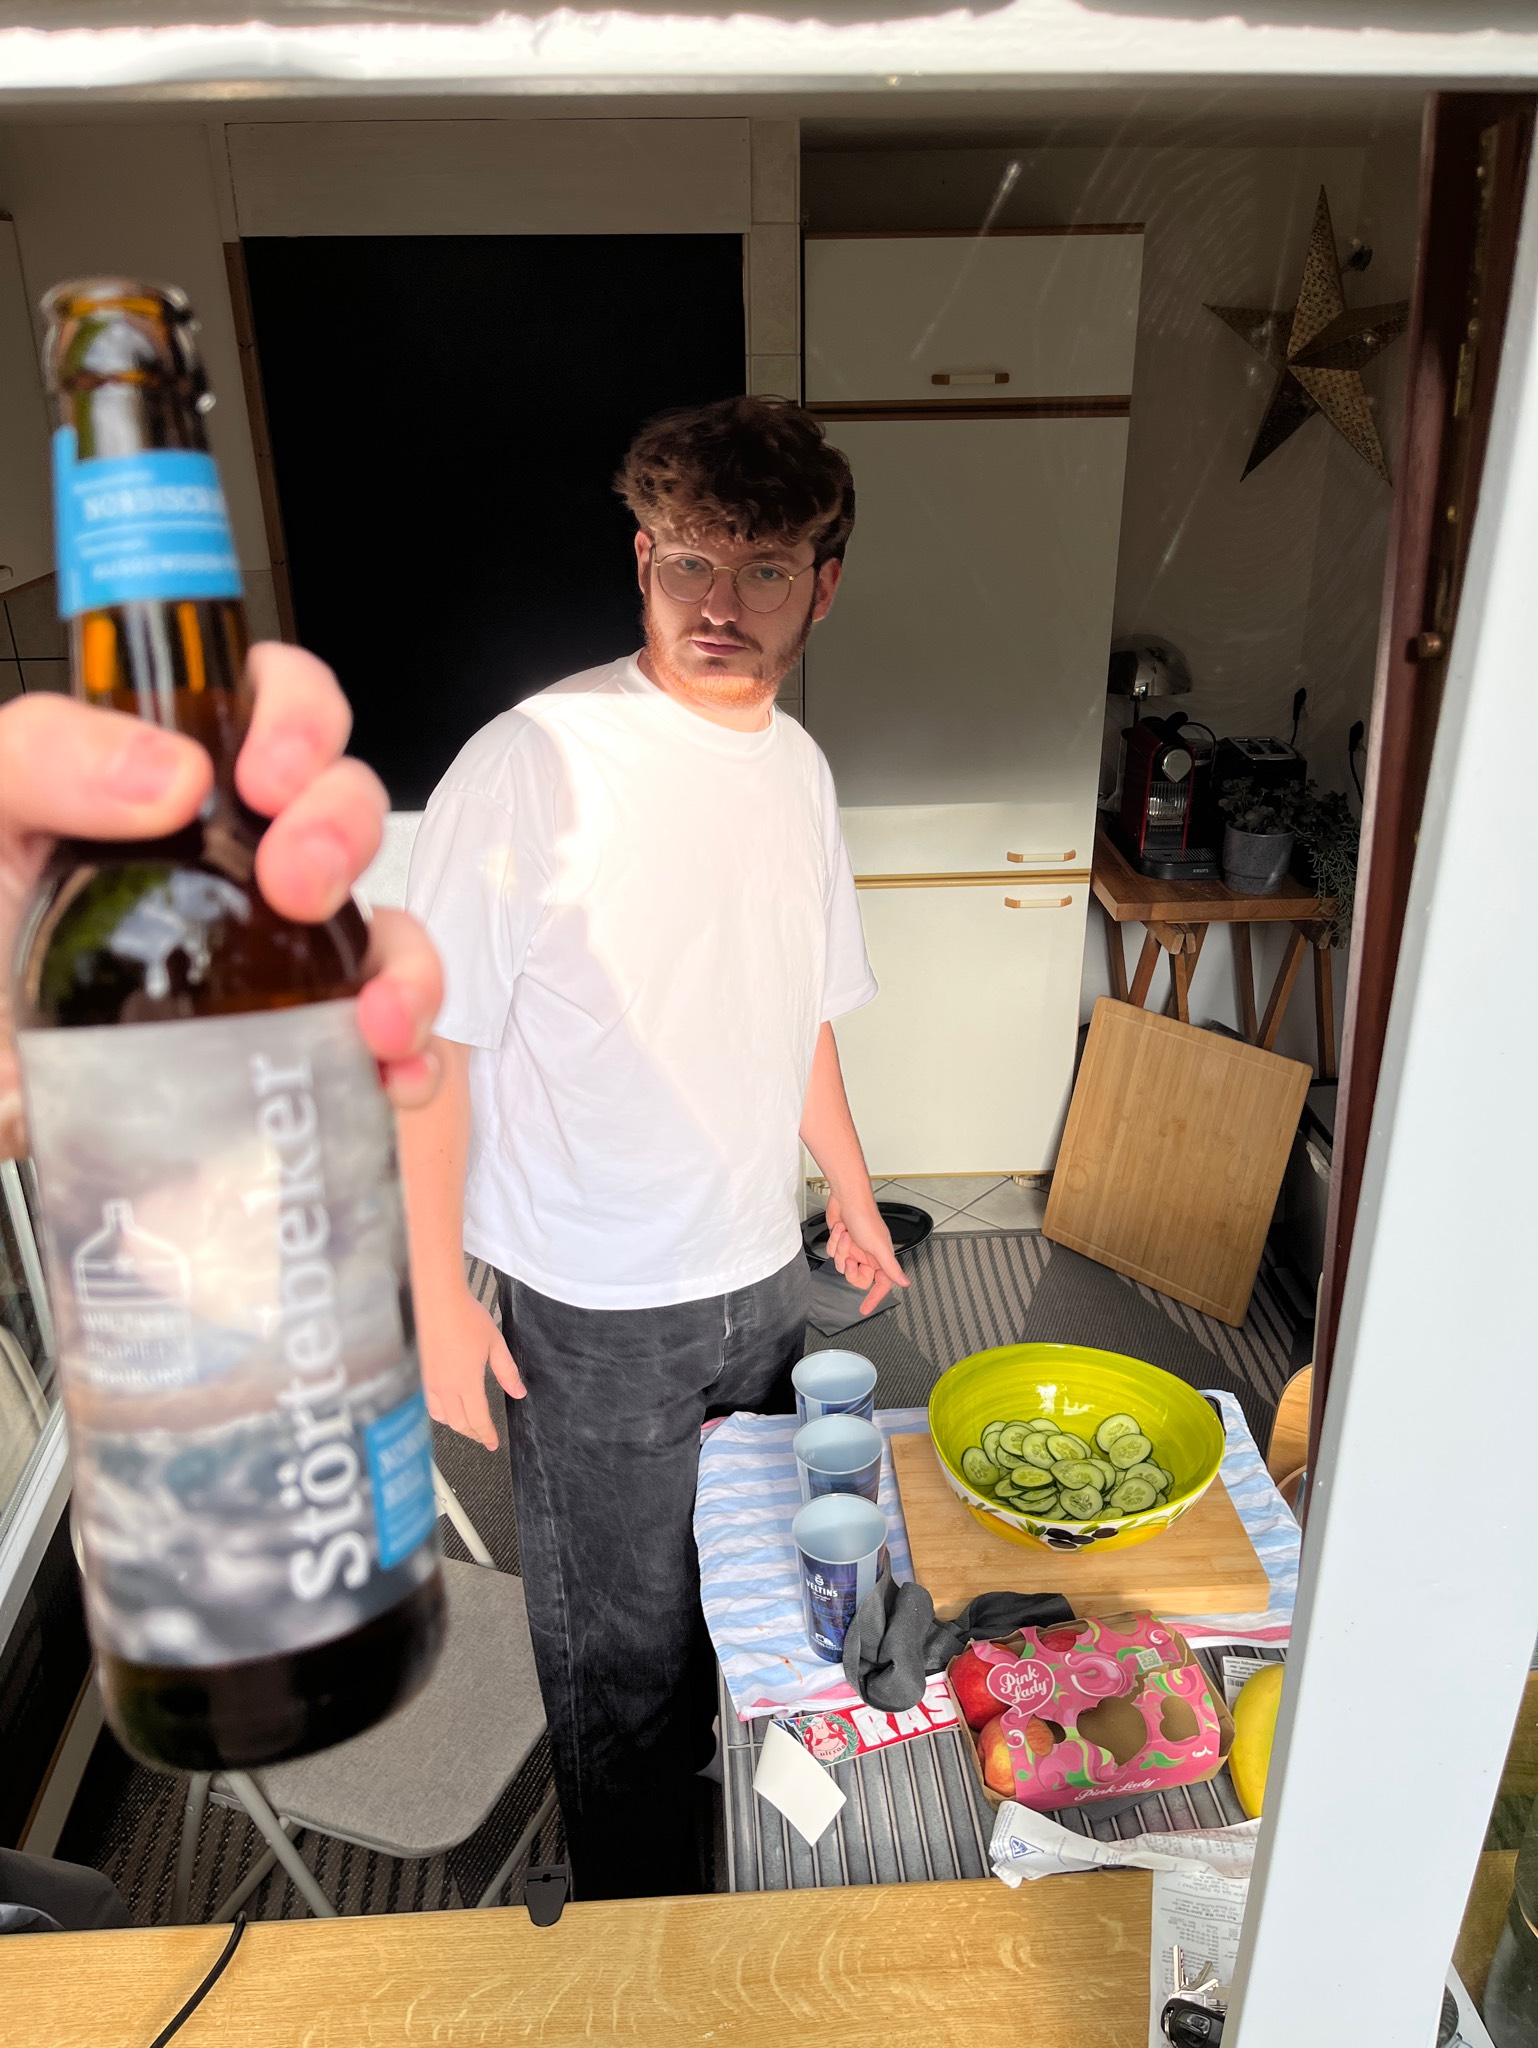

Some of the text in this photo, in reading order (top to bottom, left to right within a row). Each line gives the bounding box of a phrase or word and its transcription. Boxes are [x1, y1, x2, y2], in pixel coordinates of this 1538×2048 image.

[243, 1053, 371, 1600] Störtebeker
[805, 1578, 838, 1597] VELTINS
[1000, 1665, 1039, 1694] Pink
[1011, 1679, 1049, 1704] Lady
[1074, 1778, 1156, 1801] Pink Lady
